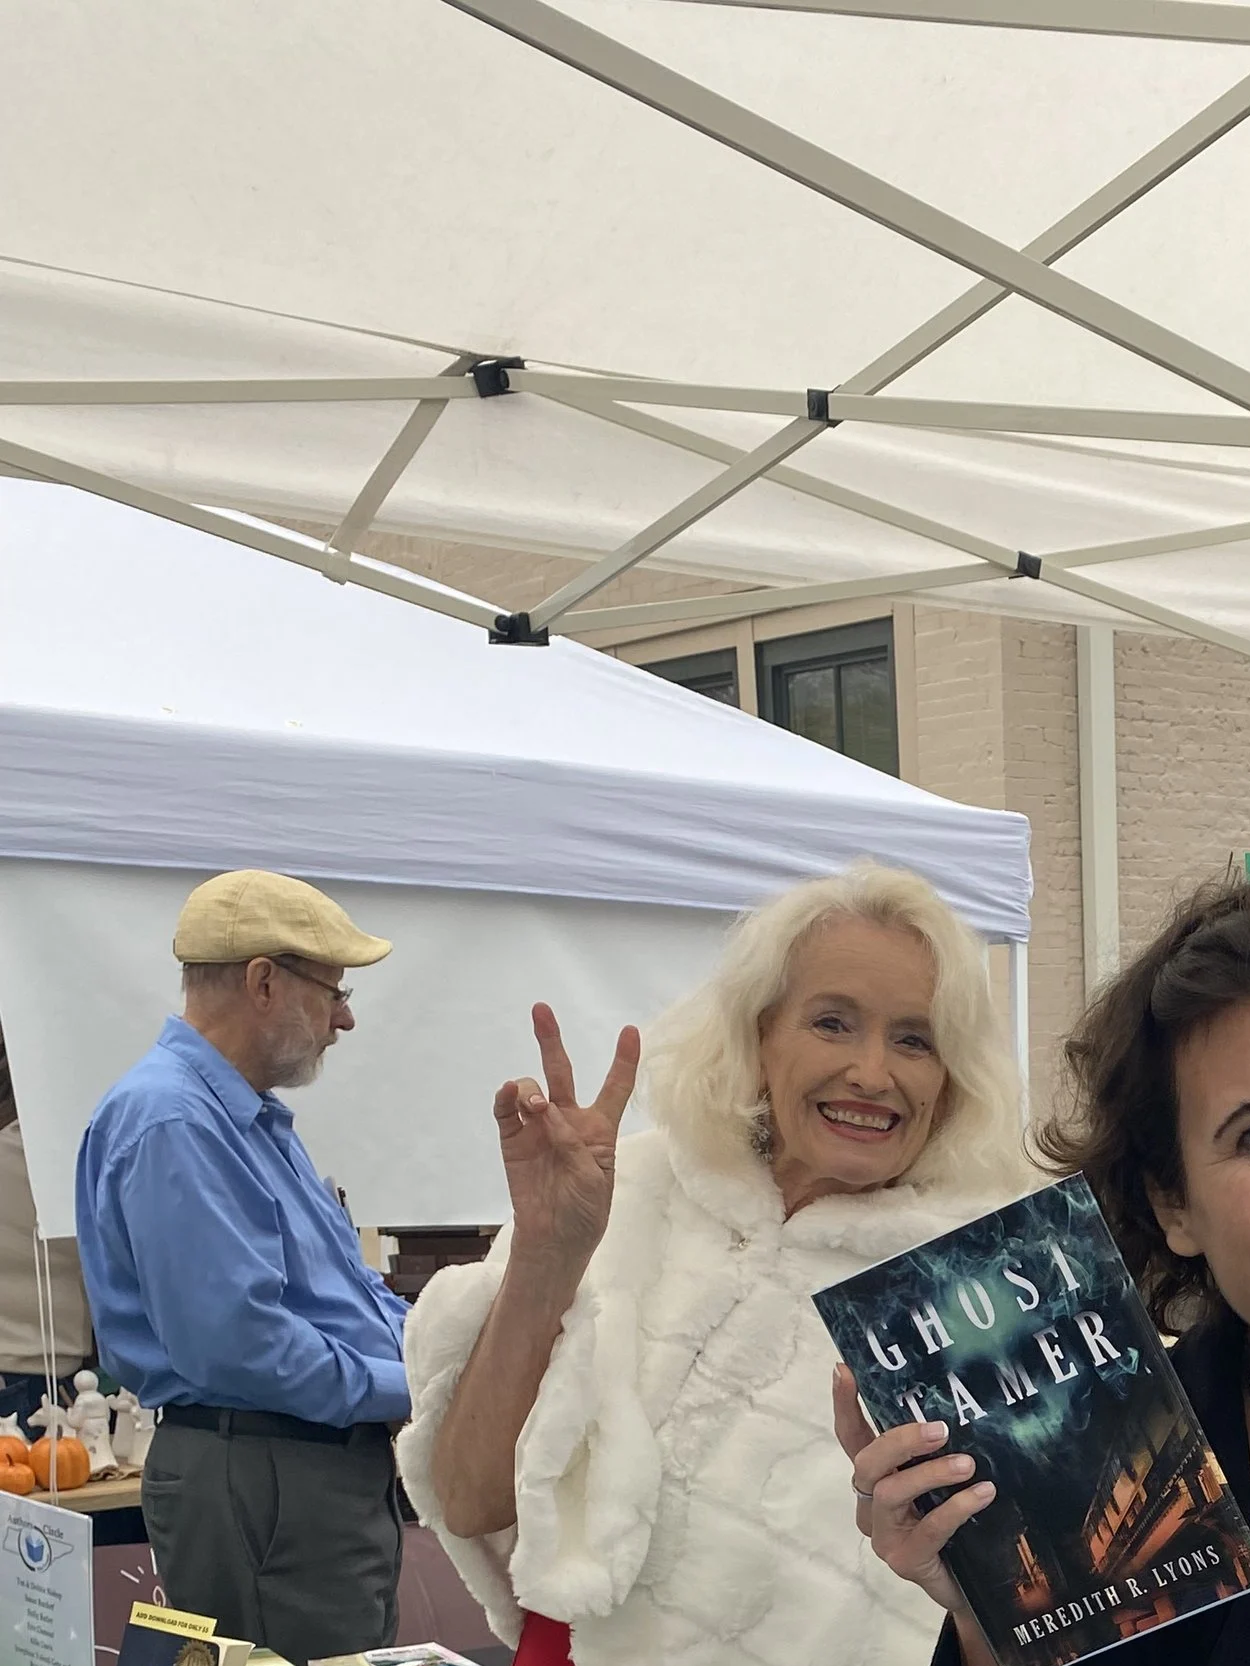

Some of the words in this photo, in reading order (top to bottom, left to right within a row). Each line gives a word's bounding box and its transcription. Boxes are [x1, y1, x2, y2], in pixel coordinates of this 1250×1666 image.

[865, 1242, 1080, 1372] GHOST
[897, 1310, 1121, 1426] TAMER
[148, 1614, 178, 1626] DOWNLOAD
[178, 1620, 188, 1628] FOR
[188, 1623, 202, 1631] ONLY
[1012, 1586, 1121, 1645] MEREDITH
[1126, 1573, 1149, 1598] R.
[1153, 1544, 1221, 1588] LYONS
